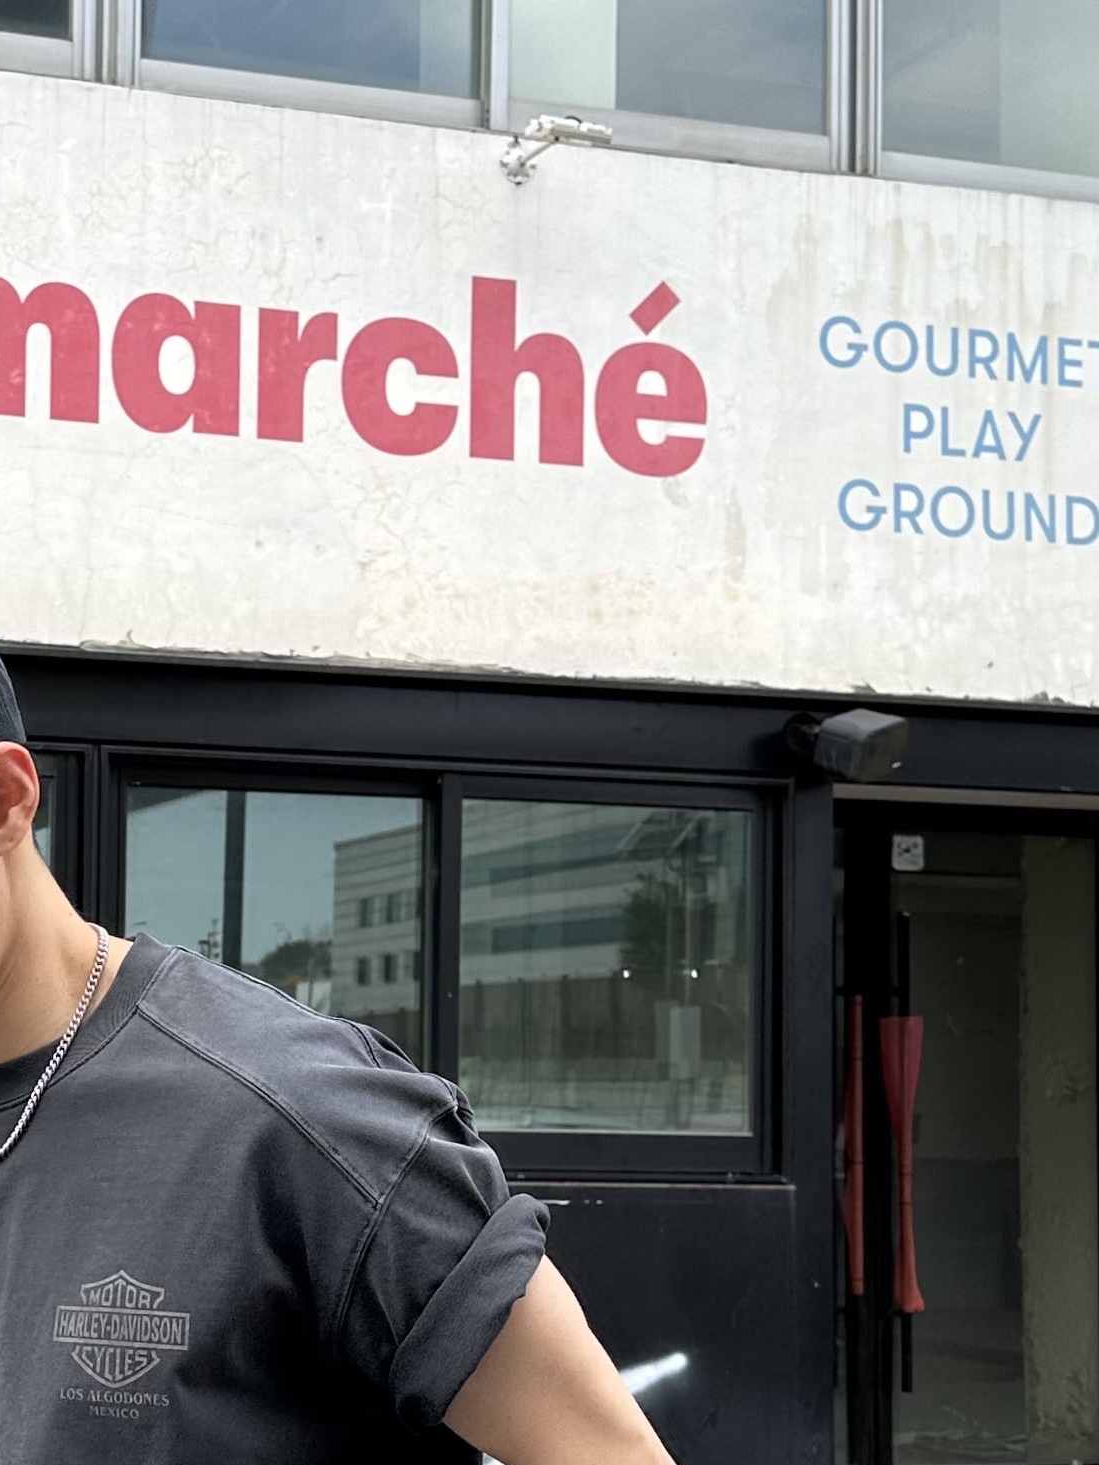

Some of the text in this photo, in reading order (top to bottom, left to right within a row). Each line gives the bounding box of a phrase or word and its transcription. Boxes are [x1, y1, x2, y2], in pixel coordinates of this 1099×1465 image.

[901, 403, 1043, 463] PLAY
[837, 478, 1099, 547] GROUND
[88, 1278, 151, 1309] MOTOR
[58, 1310, 184, 1345] HARLEY-DAVIDSON
[81, 1346, 148, 1382] CYCLES
[59, 1387, 171, 1407] LOS ALGODONES
[88, 1405, 140, 1420] MEXICO
